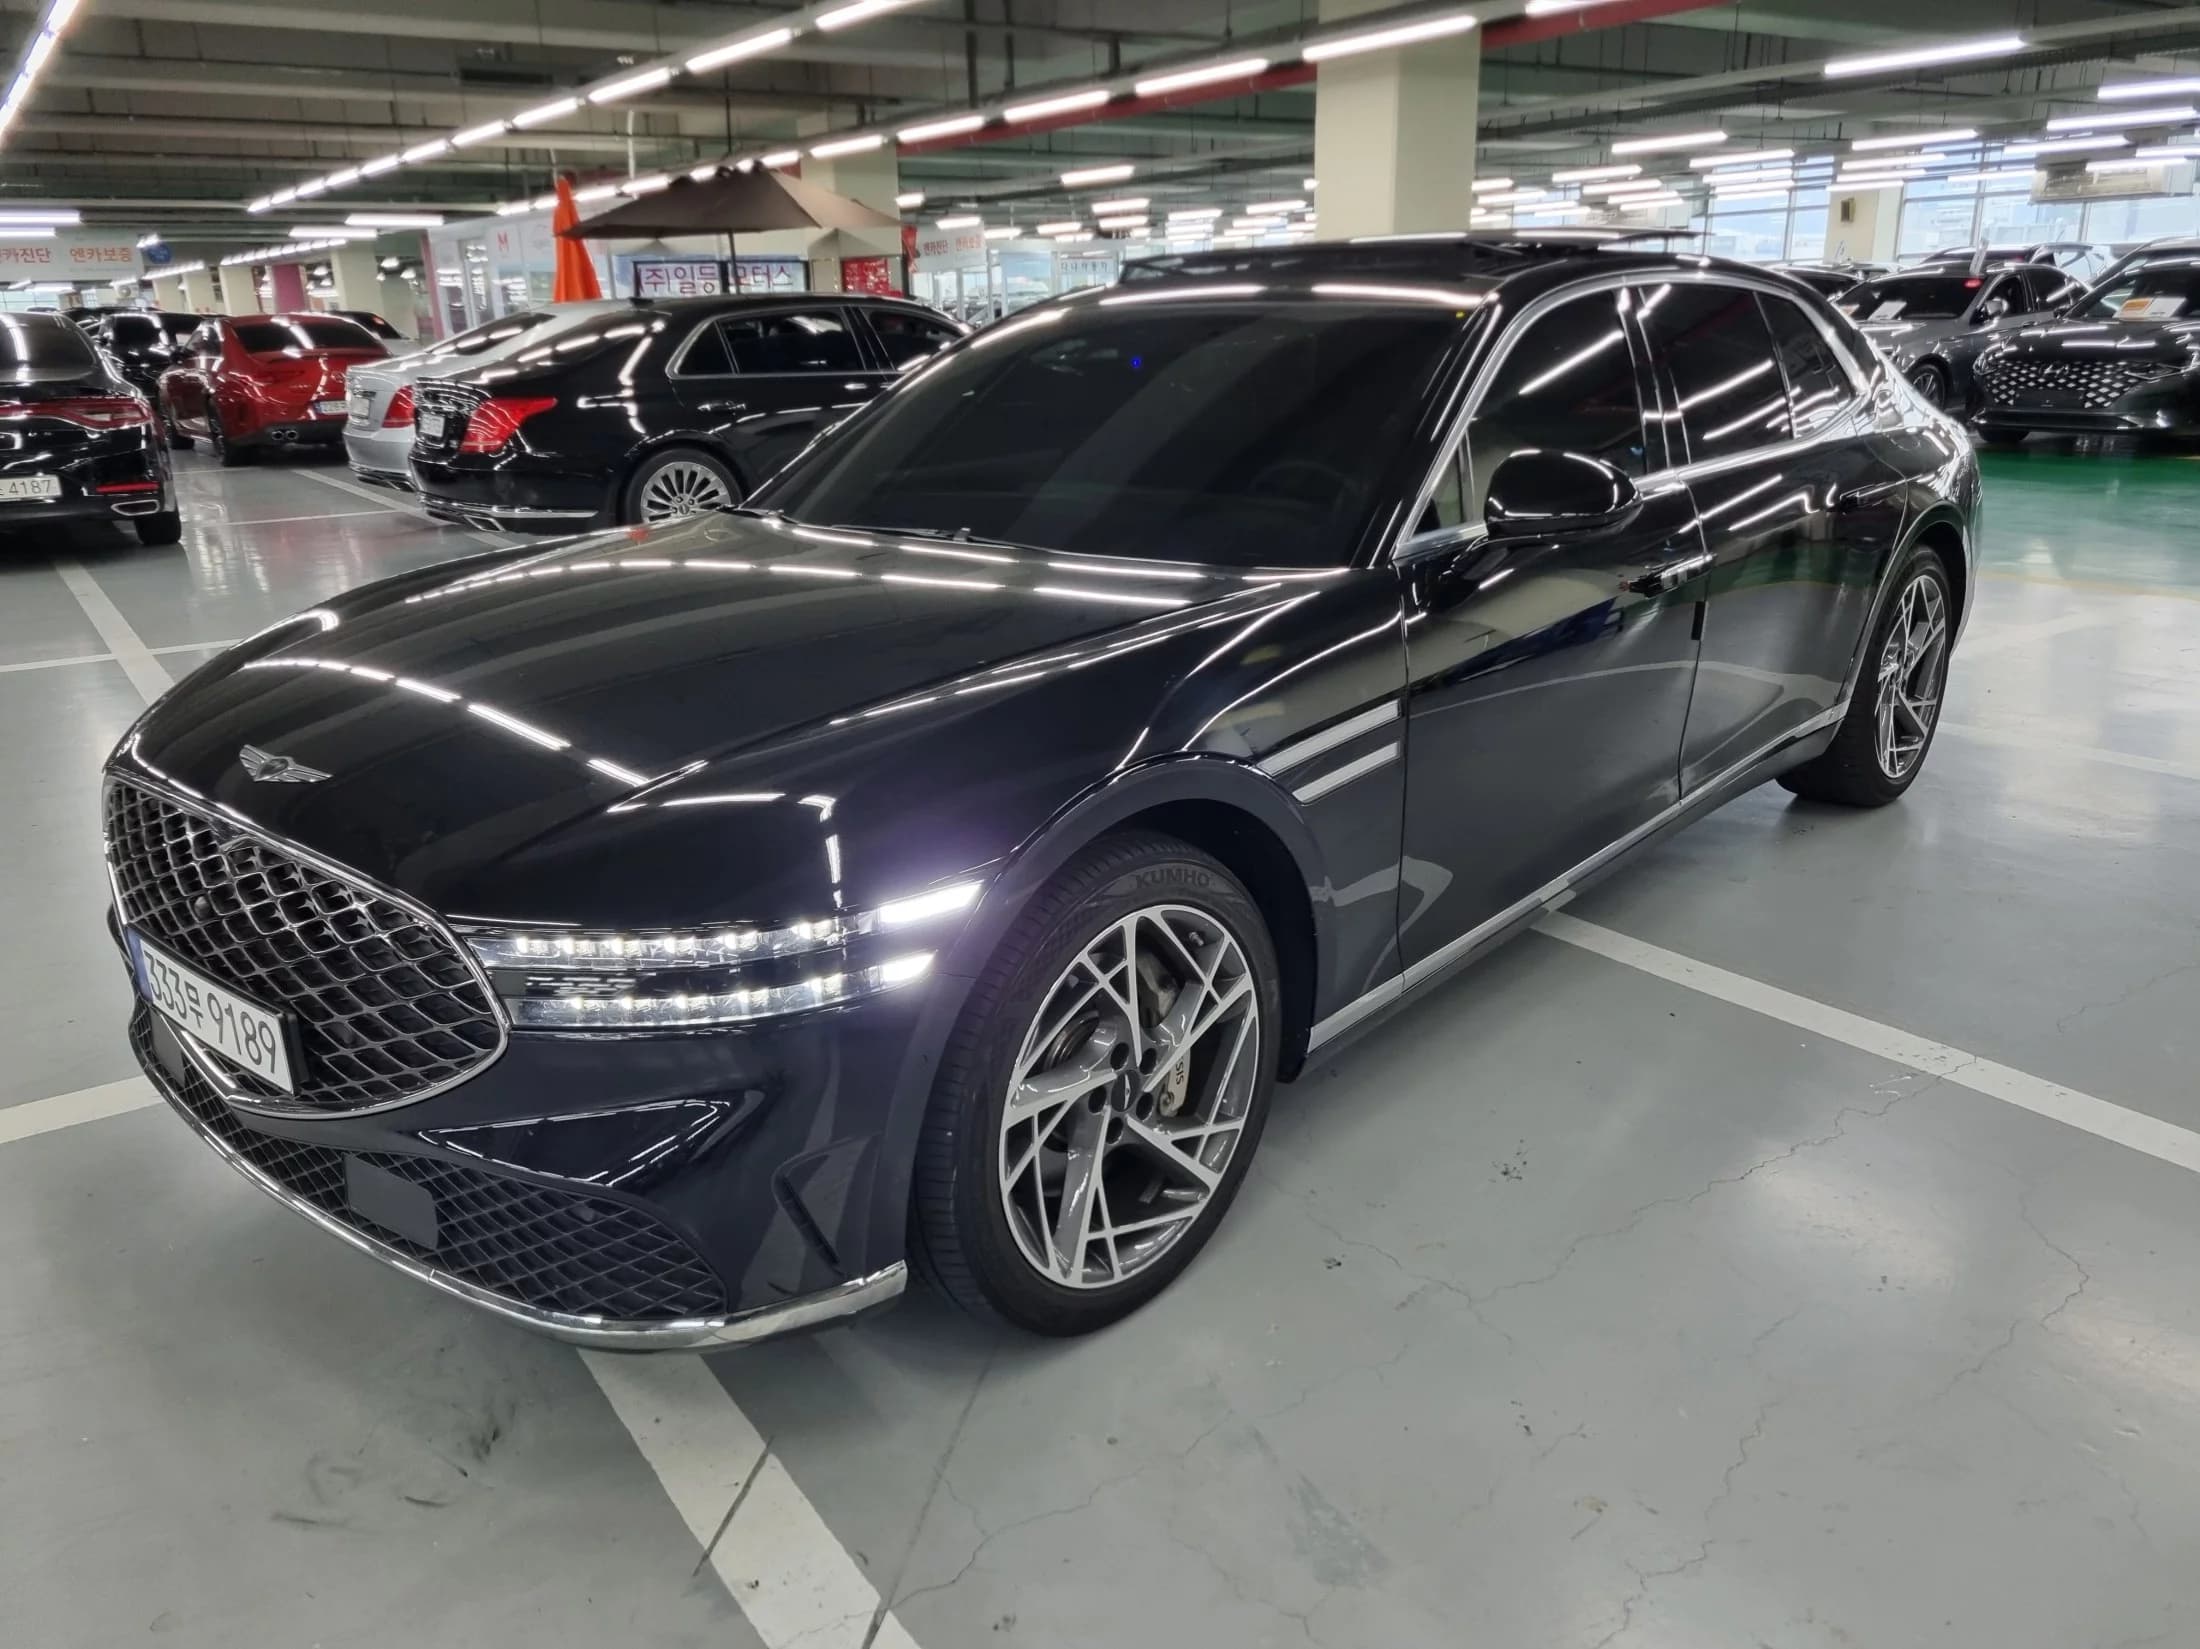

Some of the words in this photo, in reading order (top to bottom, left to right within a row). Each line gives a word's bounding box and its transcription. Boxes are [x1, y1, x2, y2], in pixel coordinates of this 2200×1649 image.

[0, 247, 51, 264] 카진단
[69, 247, 133, 263] 엔카보증
[9, 479, 50, 495] 4187
[1135, 868, 1210, 889] KUMHO
[144, 950, 203, 1029] 333무
[207, 992, 276, 1074] 9189
